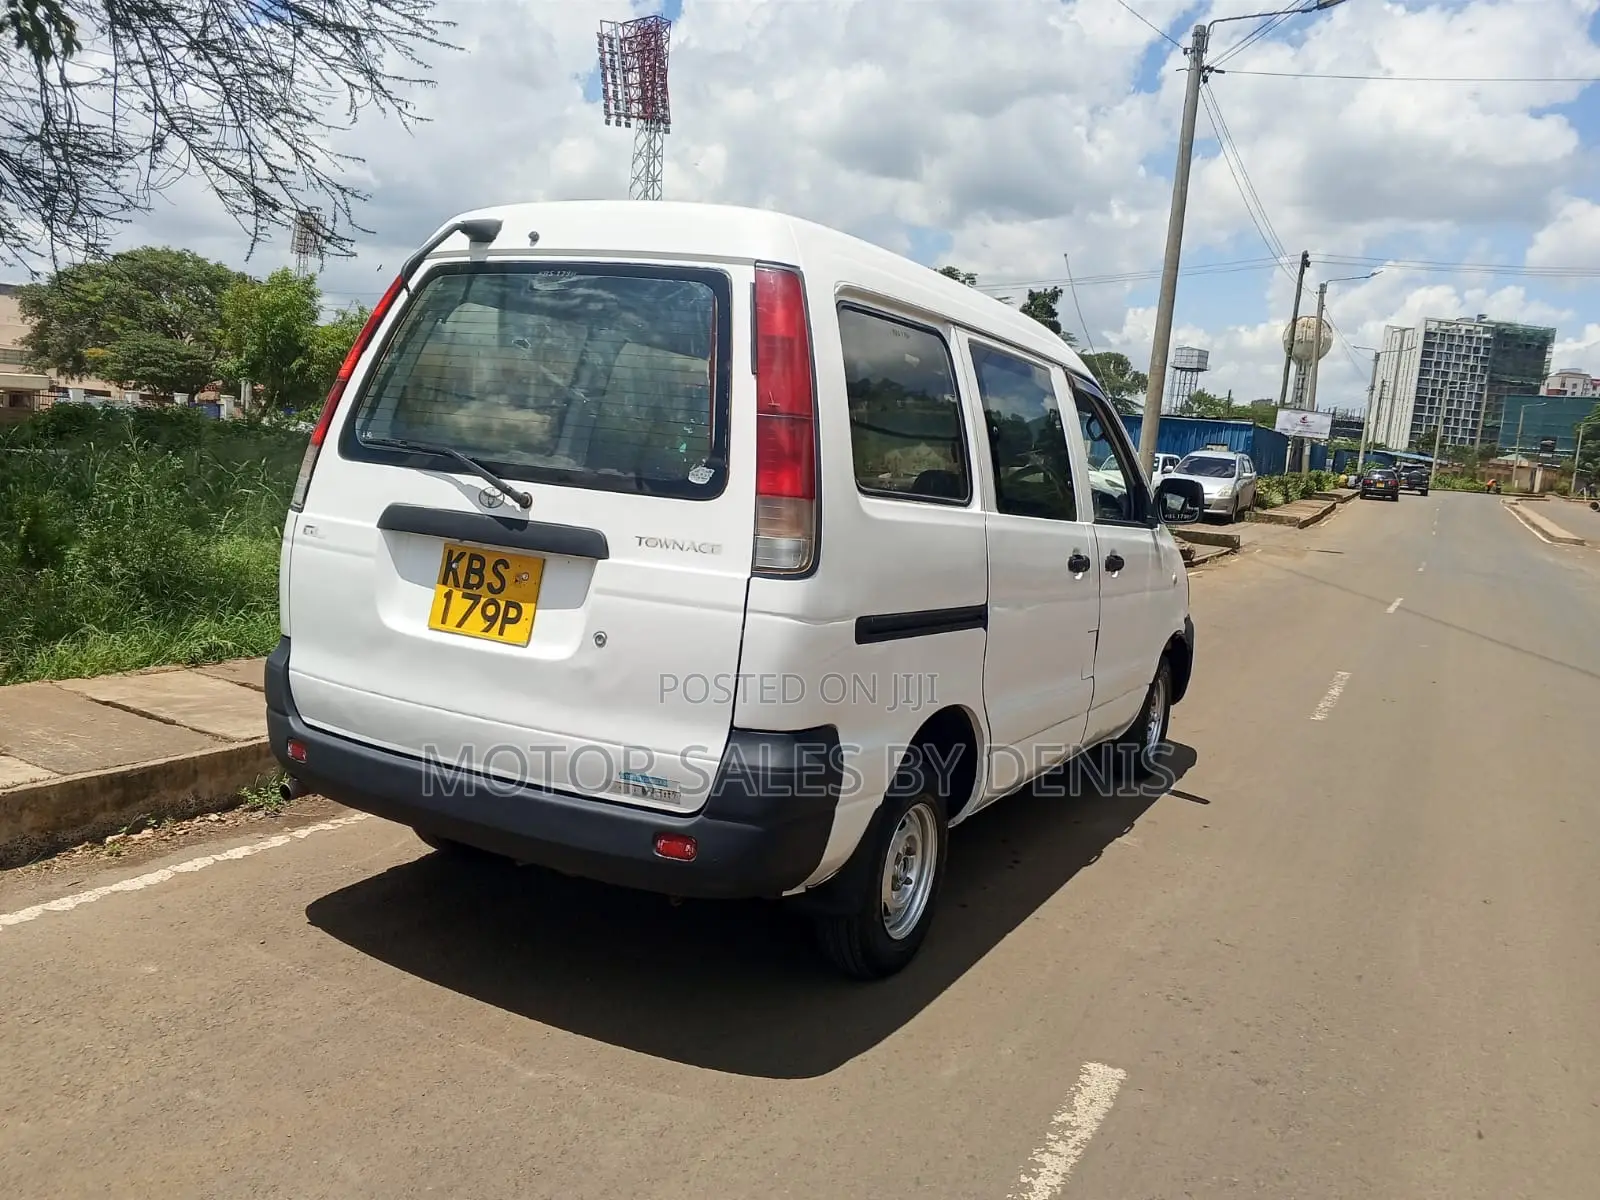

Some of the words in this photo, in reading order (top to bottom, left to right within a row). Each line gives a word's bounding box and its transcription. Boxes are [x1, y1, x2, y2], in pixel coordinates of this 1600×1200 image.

[635, 535, 722, 555] TOWNACE
[442, 549, 510, 595] KBS
[440, 588, 523, 636] 179P
